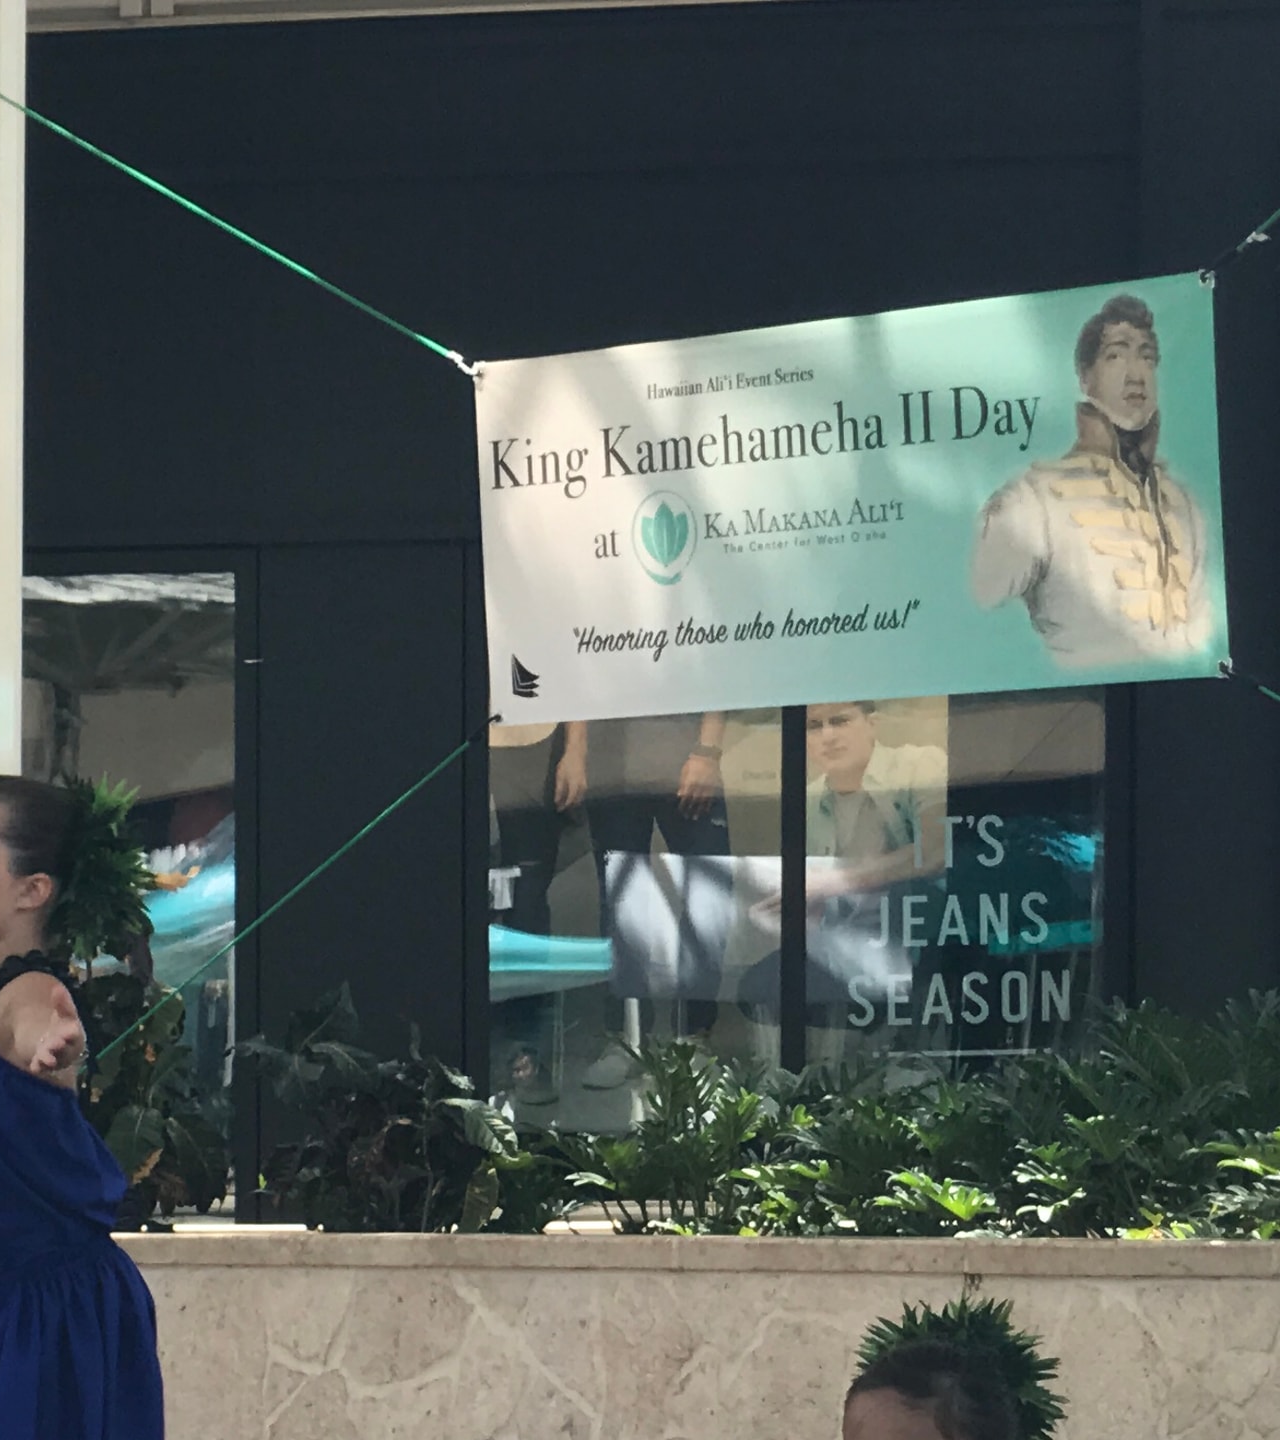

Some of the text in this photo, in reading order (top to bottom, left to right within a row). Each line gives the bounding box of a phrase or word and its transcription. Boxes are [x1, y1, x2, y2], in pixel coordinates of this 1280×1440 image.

[647, 380, 703, 399] Hawaiian
[736, 372, 772, 390] Event
[774, 366, 814, 385] Series
[489, 385, 1041, 499] King Kamehameha II Day
[723, 542, 743, 554] The
[749, 538, 788, 553] Center
[794, 537, 811, 548] for
[816, 533, 845, 546] West
[743, 508, 842, 535] MAKANA
[594, 529, 620, 560] at
[675, 616, 729, 647] those
[734, 611, 775, 642] who
[781, 603, 868, 638] honored
[913, 814, 1005, 869] IT'S
[867, 892, 1049, 948] JEANS
[847, 969, 1071, 1028] SEASON
